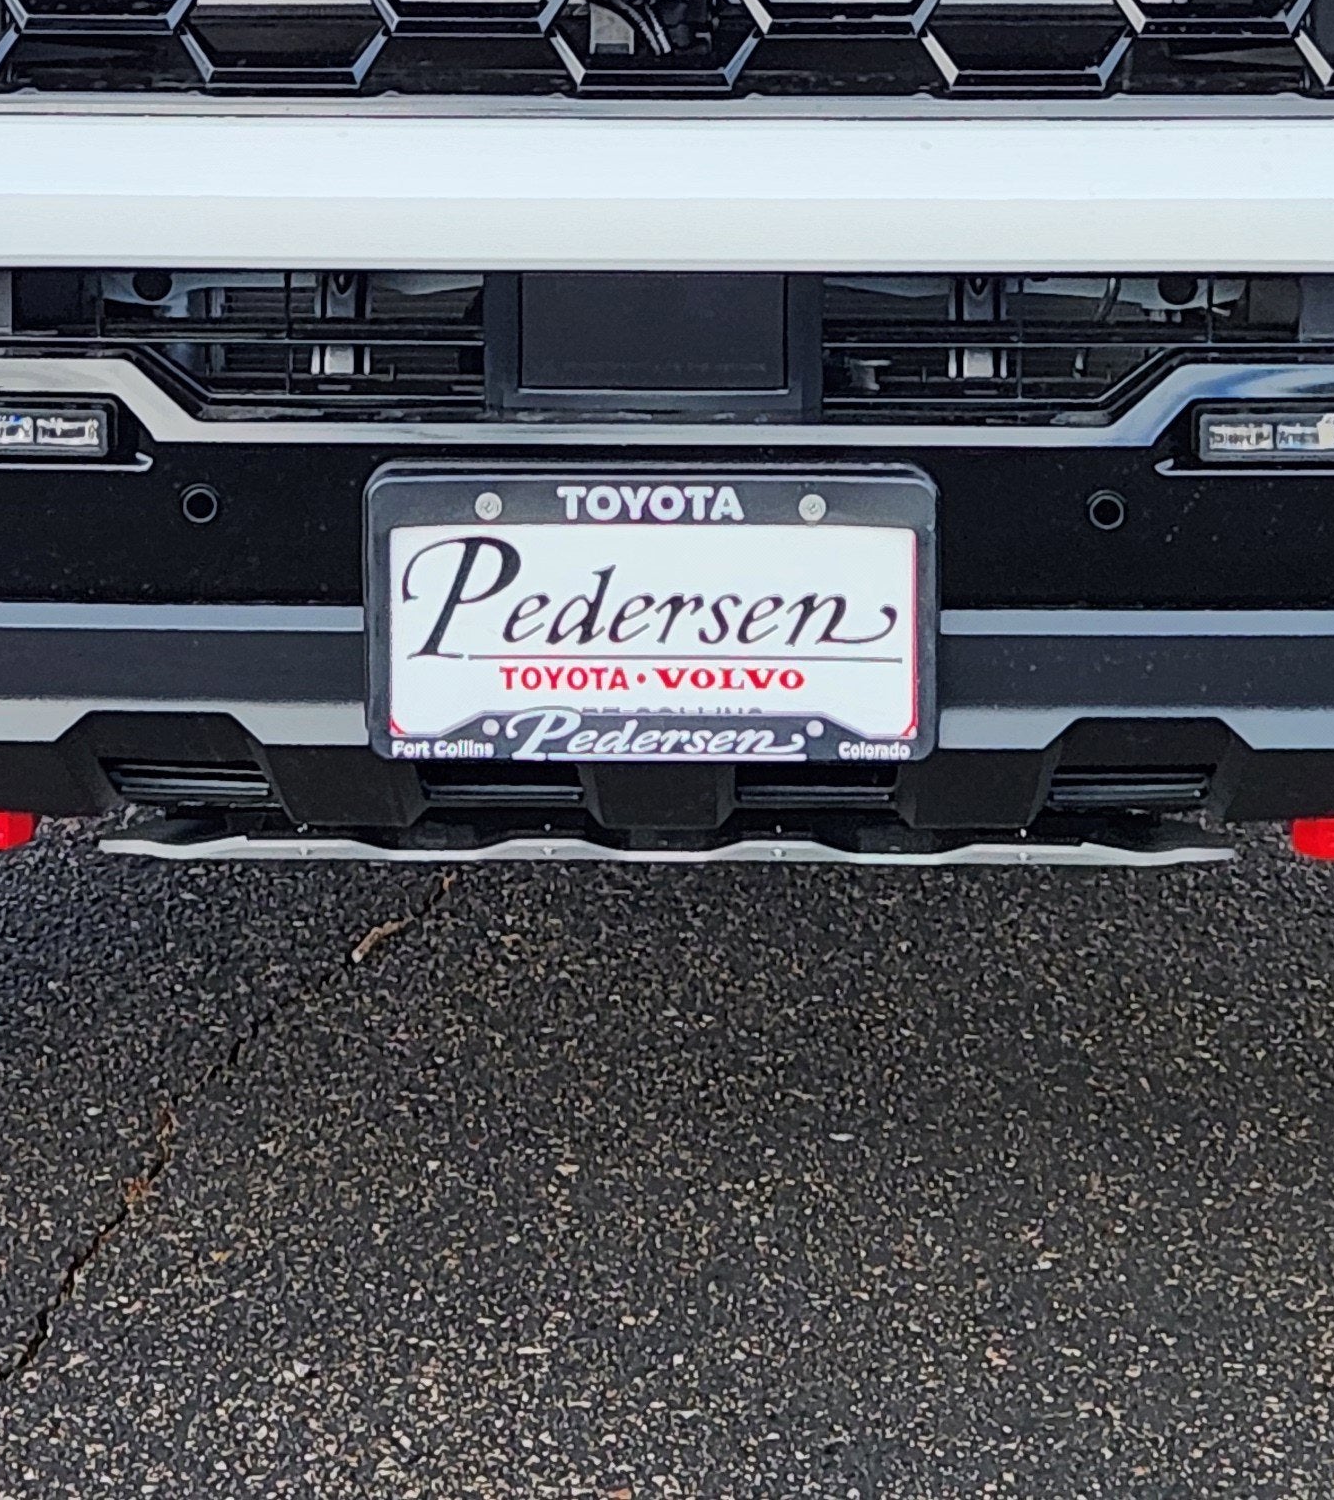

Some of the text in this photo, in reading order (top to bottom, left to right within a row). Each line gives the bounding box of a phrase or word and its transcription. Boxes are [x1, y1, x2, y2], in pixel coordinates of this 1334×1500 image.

[557, 486, 745, 521] TOYOTA
[401, 535, 899, 660] Pedersen
[499, 667, 805, 691] TOYOTA VOLVO
[505, 705, 807, 761] Pedersen
[391, 738, 495, 759] Fort Collins
[838, 741, 911, 760] Colorado
